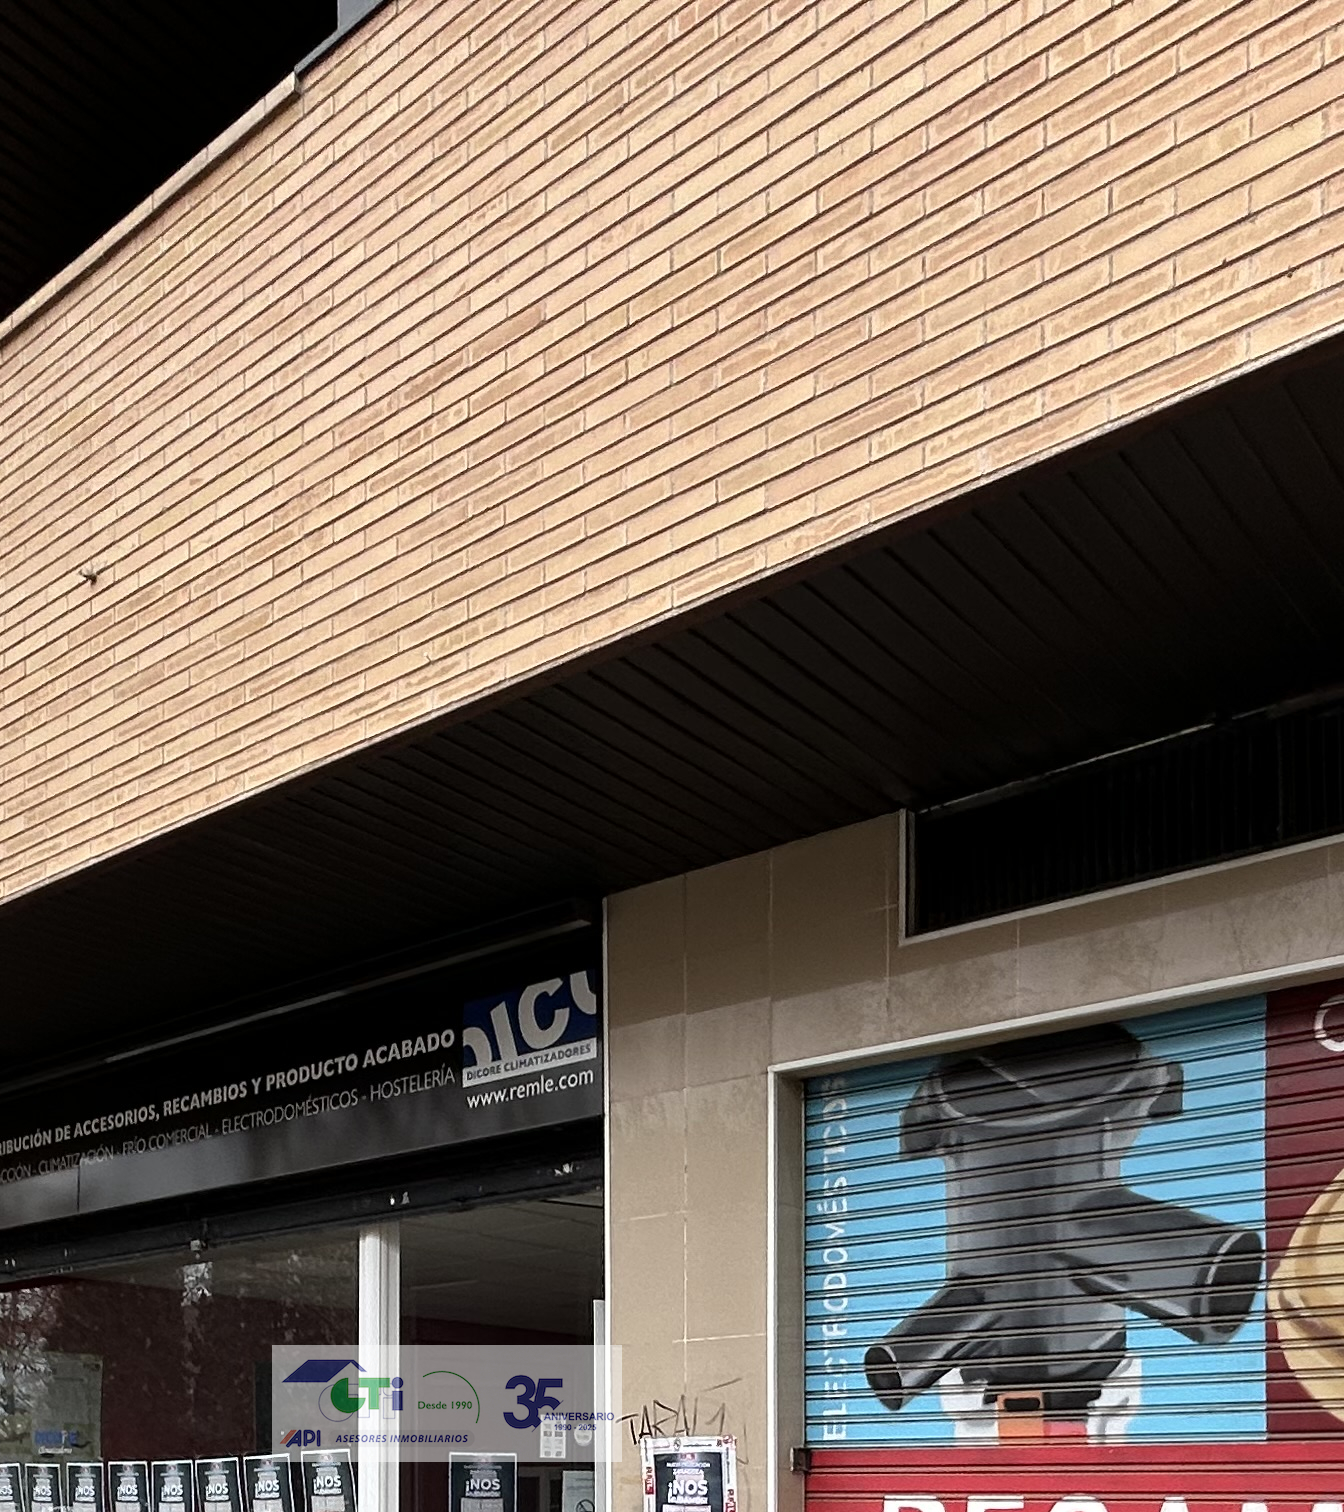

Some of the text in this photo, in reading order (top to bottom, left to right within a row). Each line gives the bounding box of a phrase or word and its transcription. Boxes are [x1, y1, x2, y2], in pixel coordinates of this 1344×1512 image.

[466, 1044, 591, 1081] DICORE CLIMATIZADORES
[55, 1125, 71, 1143] DE
[74, 1104, 160, 1139] ACCESORIOS,
[163, 1081, 248, 1117] RECAMBIOS
[251, 1077, 262, 1095] Y
[266, 1053, 358, 1091] PRODUCTO
[362, 1029, 455, 1069] ACABADO
[466, 1069, 594, 1109] www.remle.com
[122, 1135, 146, 1156] FRÍO
[148, 1122, 212, 1151] COMERCIAL
[222, 1088, 359, 1135] ELECTRODOMÉSTICOS
[370, 1063, 456, 1102] HOSTELERÍA
[465, 1478, 501, 1491] ¡NOS
[668, 1479, 709, 1496] ¡NOS
